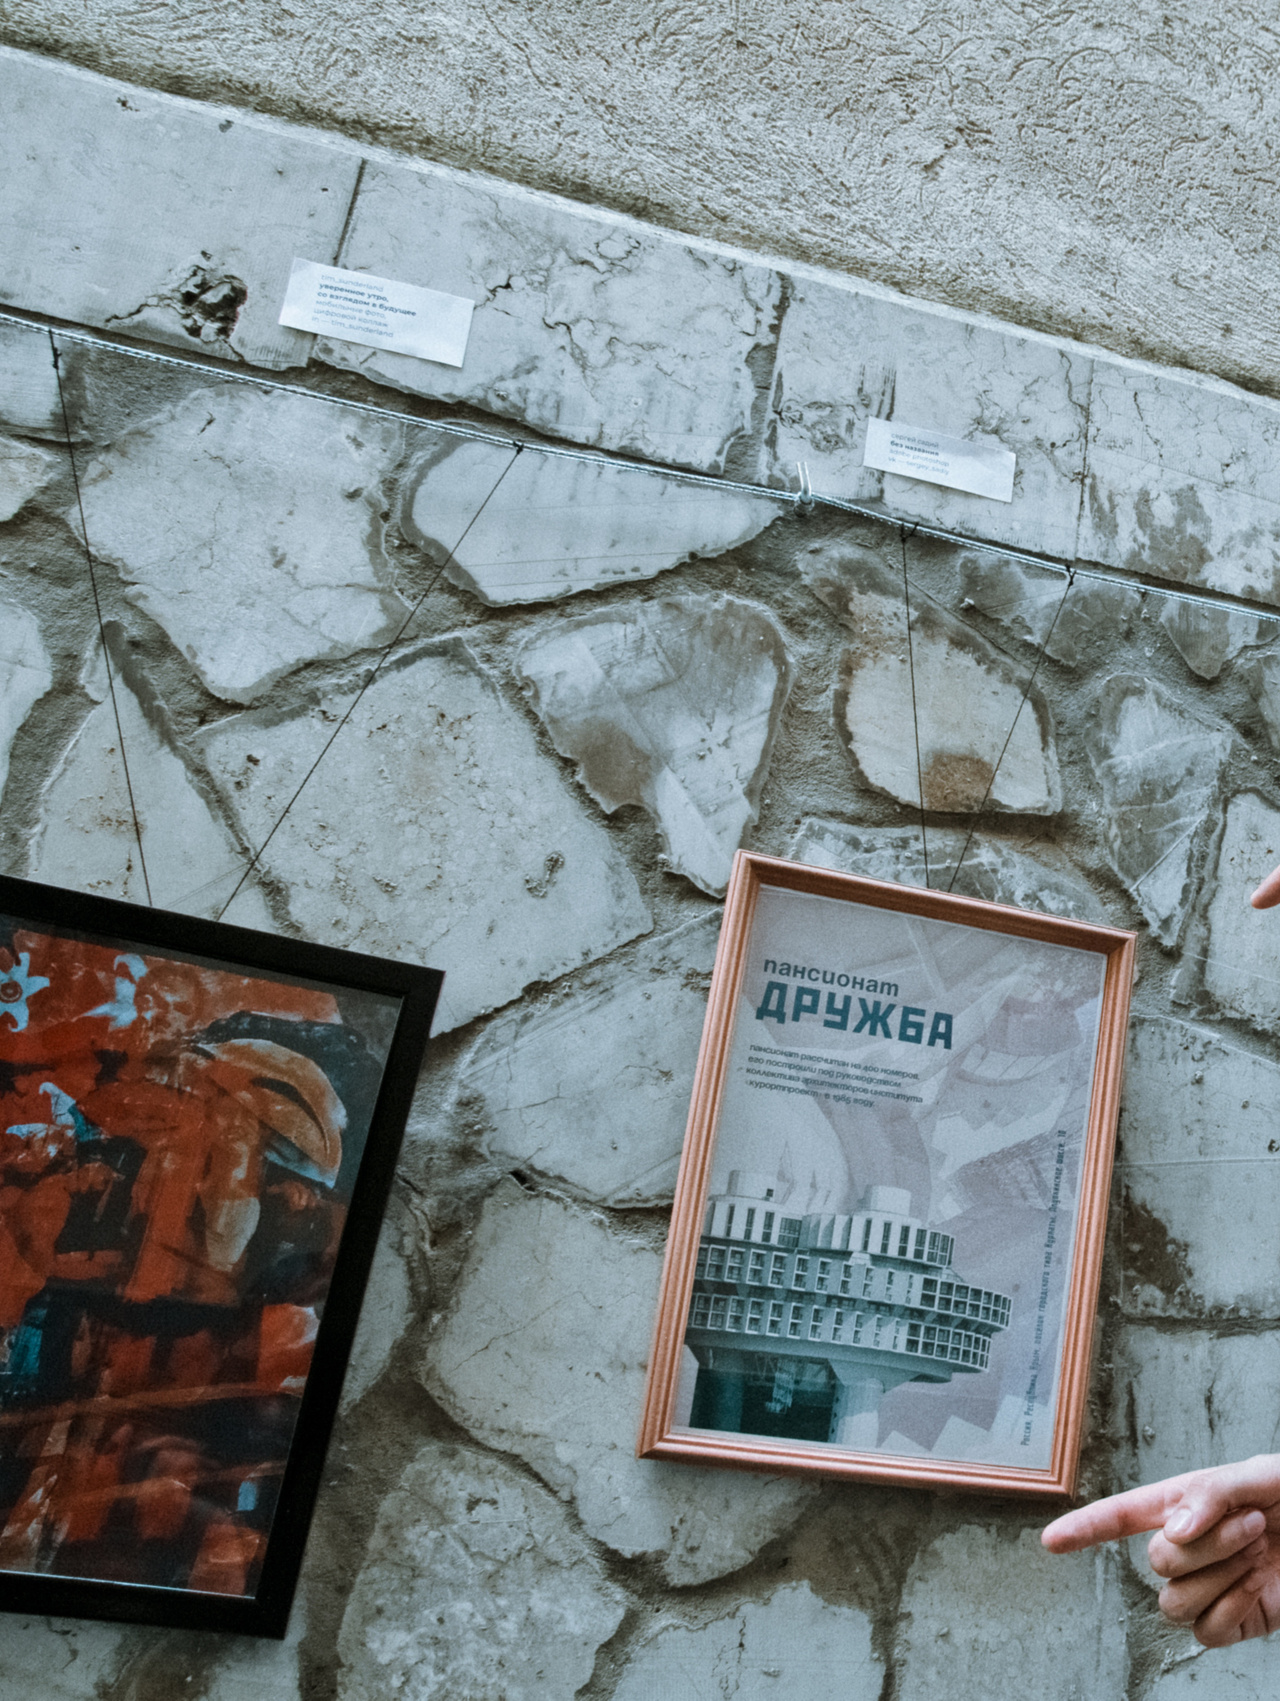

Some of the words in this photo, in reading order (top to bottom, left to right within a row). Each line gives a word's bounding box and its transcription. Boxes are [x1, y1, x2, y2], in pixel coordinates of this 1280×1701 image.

[319, 283, 365, 297] уверенное
[379, 303, 417, 317] будущее
[763, 958, 900, 998] пансионат
[755, 980, 954, 1050] ДРУЖБА
[765, 1059, 817, 1073] построили
[818, 1068, 834, 1078] под
[836, 1071, 901, 1087] руководством
[850, 1062, 861, 1070] на
[746, 1067, 800, 1082] коллектива
